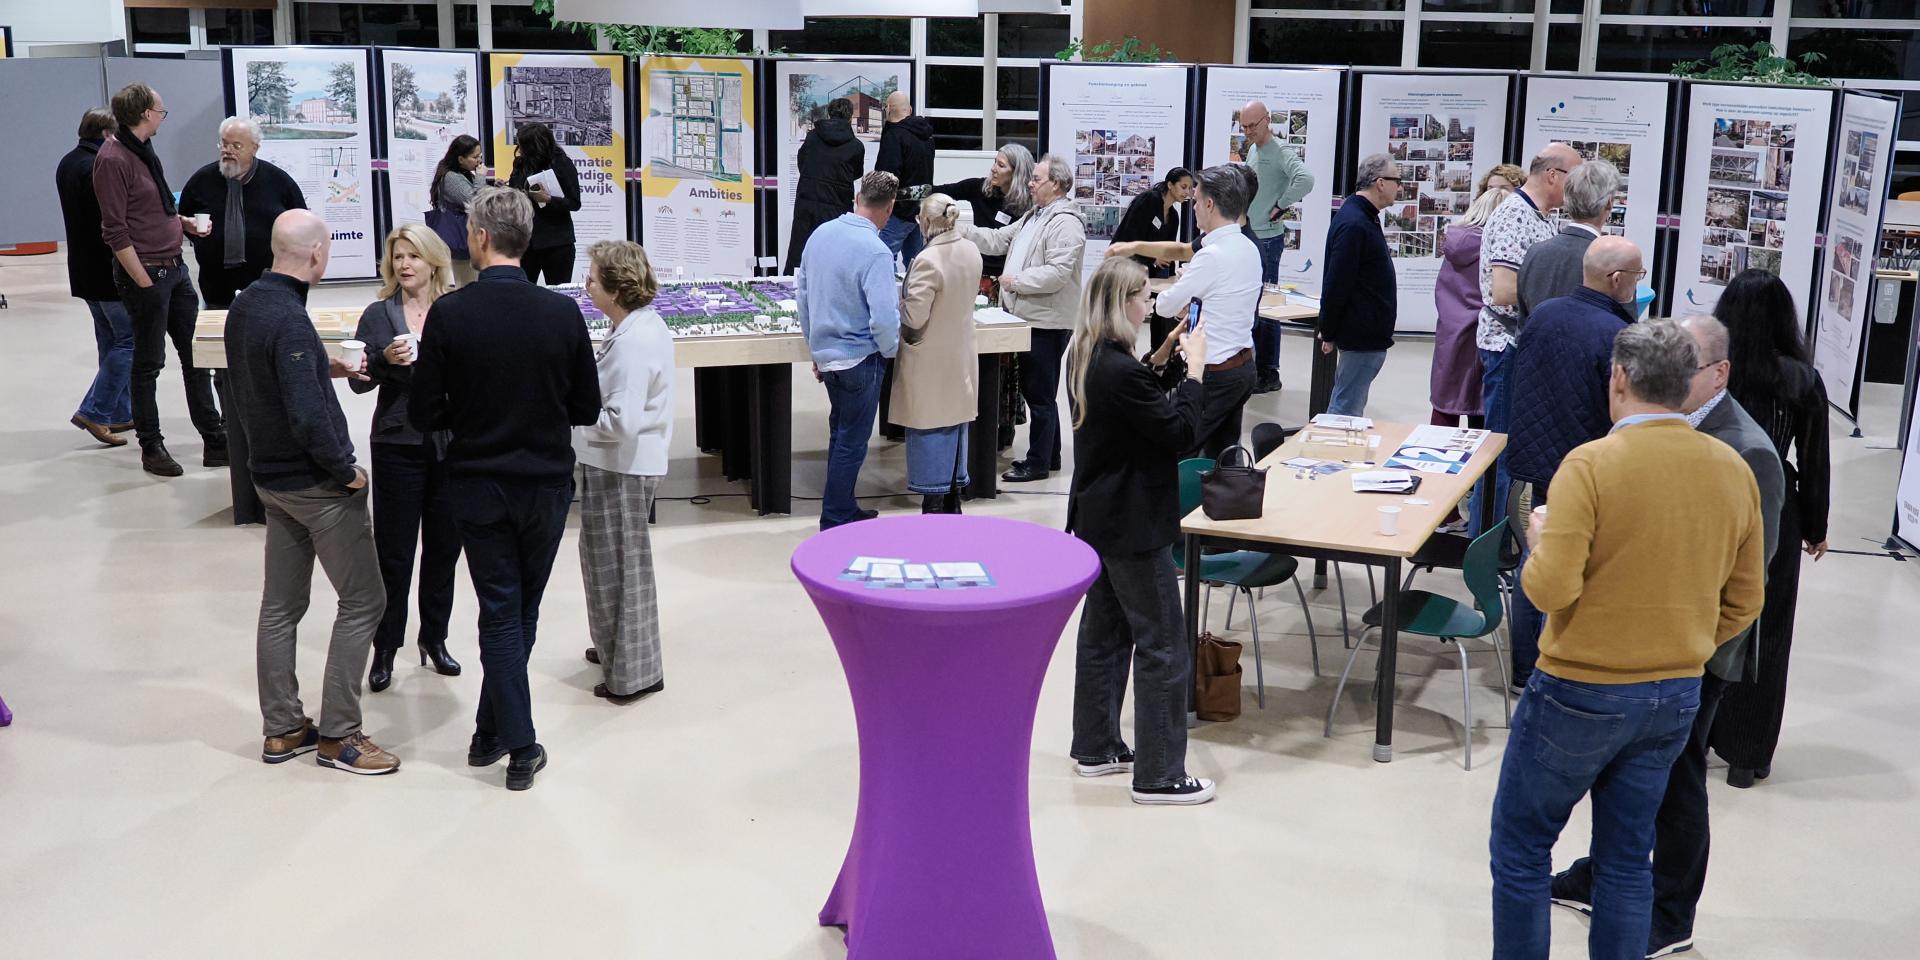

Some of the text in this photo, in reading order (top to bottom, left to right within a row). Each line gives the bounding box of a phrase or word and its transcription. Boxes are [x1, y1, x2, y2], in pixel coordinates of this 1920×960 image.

[572, 156, 612, 167] matie
[577, 169, 613, 183] ndige
[579, 182, 613, 196] swijk
[689, 187, 743, 200] Ambities
[330, 229, 364, 240] uimte
